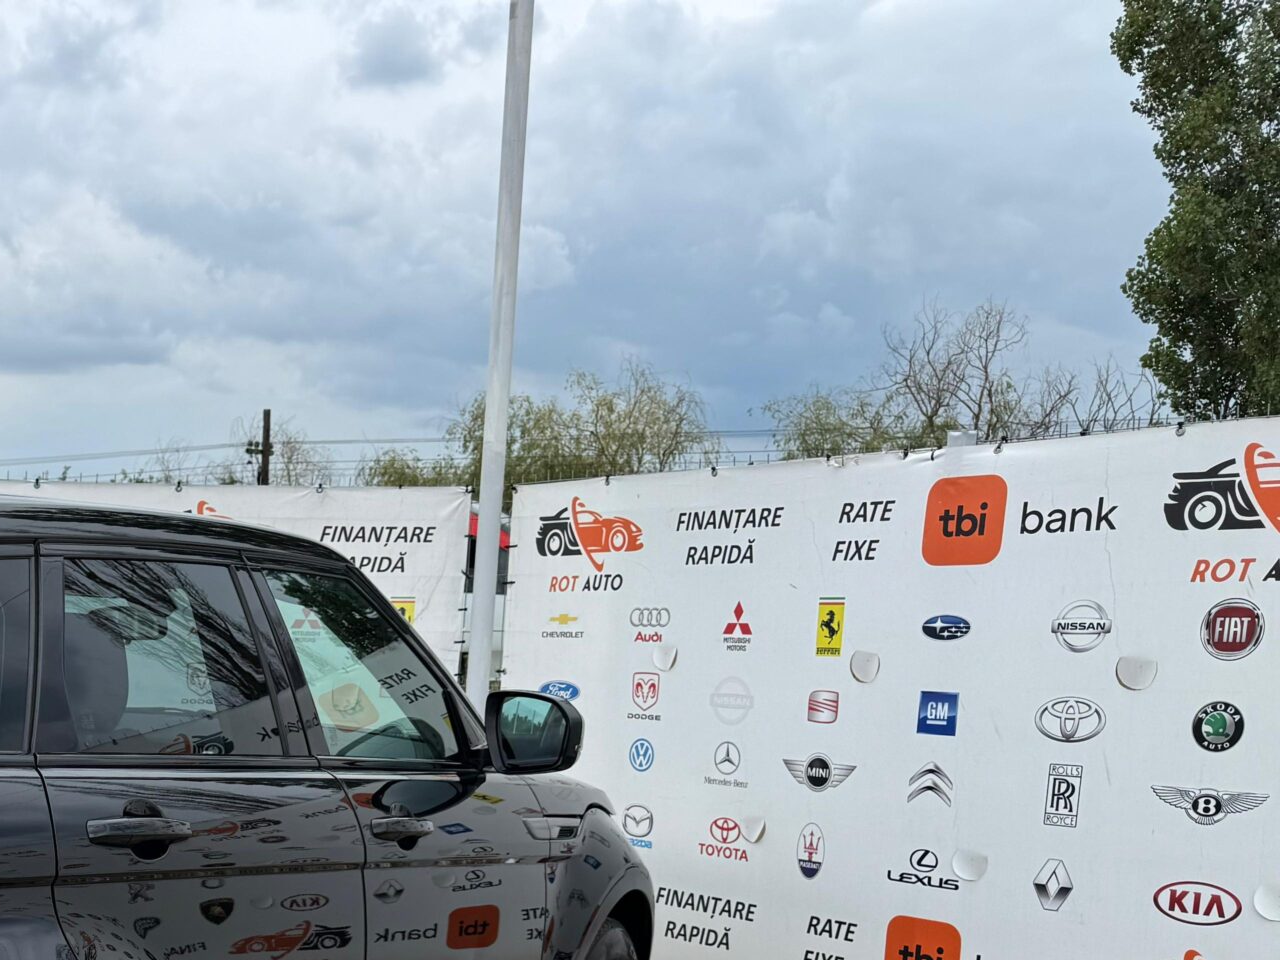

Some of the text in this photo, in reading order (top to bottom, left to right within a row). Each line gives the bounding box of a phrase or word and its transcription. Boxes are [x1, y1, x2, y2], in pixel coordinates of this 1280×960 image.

[676, 507, 784, 533] FINANȚARE
[839, 500, 896, 523] RATE
[939, 497, 1118, 537] tbi bank
[320, 526, 436, 547] FINANȚARE
[685, 539, 755, 565] RAPIDĂ
[832, 540, 880, 561] FIXE
[349, 552, 407, 573] PIDĂ
[1190, 558, 1256, 582] ROT
[549, 574, 623, 592] ROT AUTO
[634, 631, 662, 642] Audi
[1057, 621, 1107, 632] NISSAN
[1214, 617, 1251, 642] FIAT
[546, 683, 573, 699] Ford
[627, 713, 661, 721] DODGE
[927, 702, 948, 719] GM
[1202, 741, 1230, 750] AUTO
[807, 767, 829, 779] MINI
[1052, 766, 1080, 776] ROLLS
[1046, 815, 1075, 826] ROYCE
[699, 843, 748, 862] TOYOTA
[887, 870, 959, 890] LEXUS
[656, 887, 757, 922] FINANȚARE
[1168, 889, 1226, 918] KIA
[664, 921, 731, 950] RAPIDĂ
[807, 916, 857, 942] RATE
